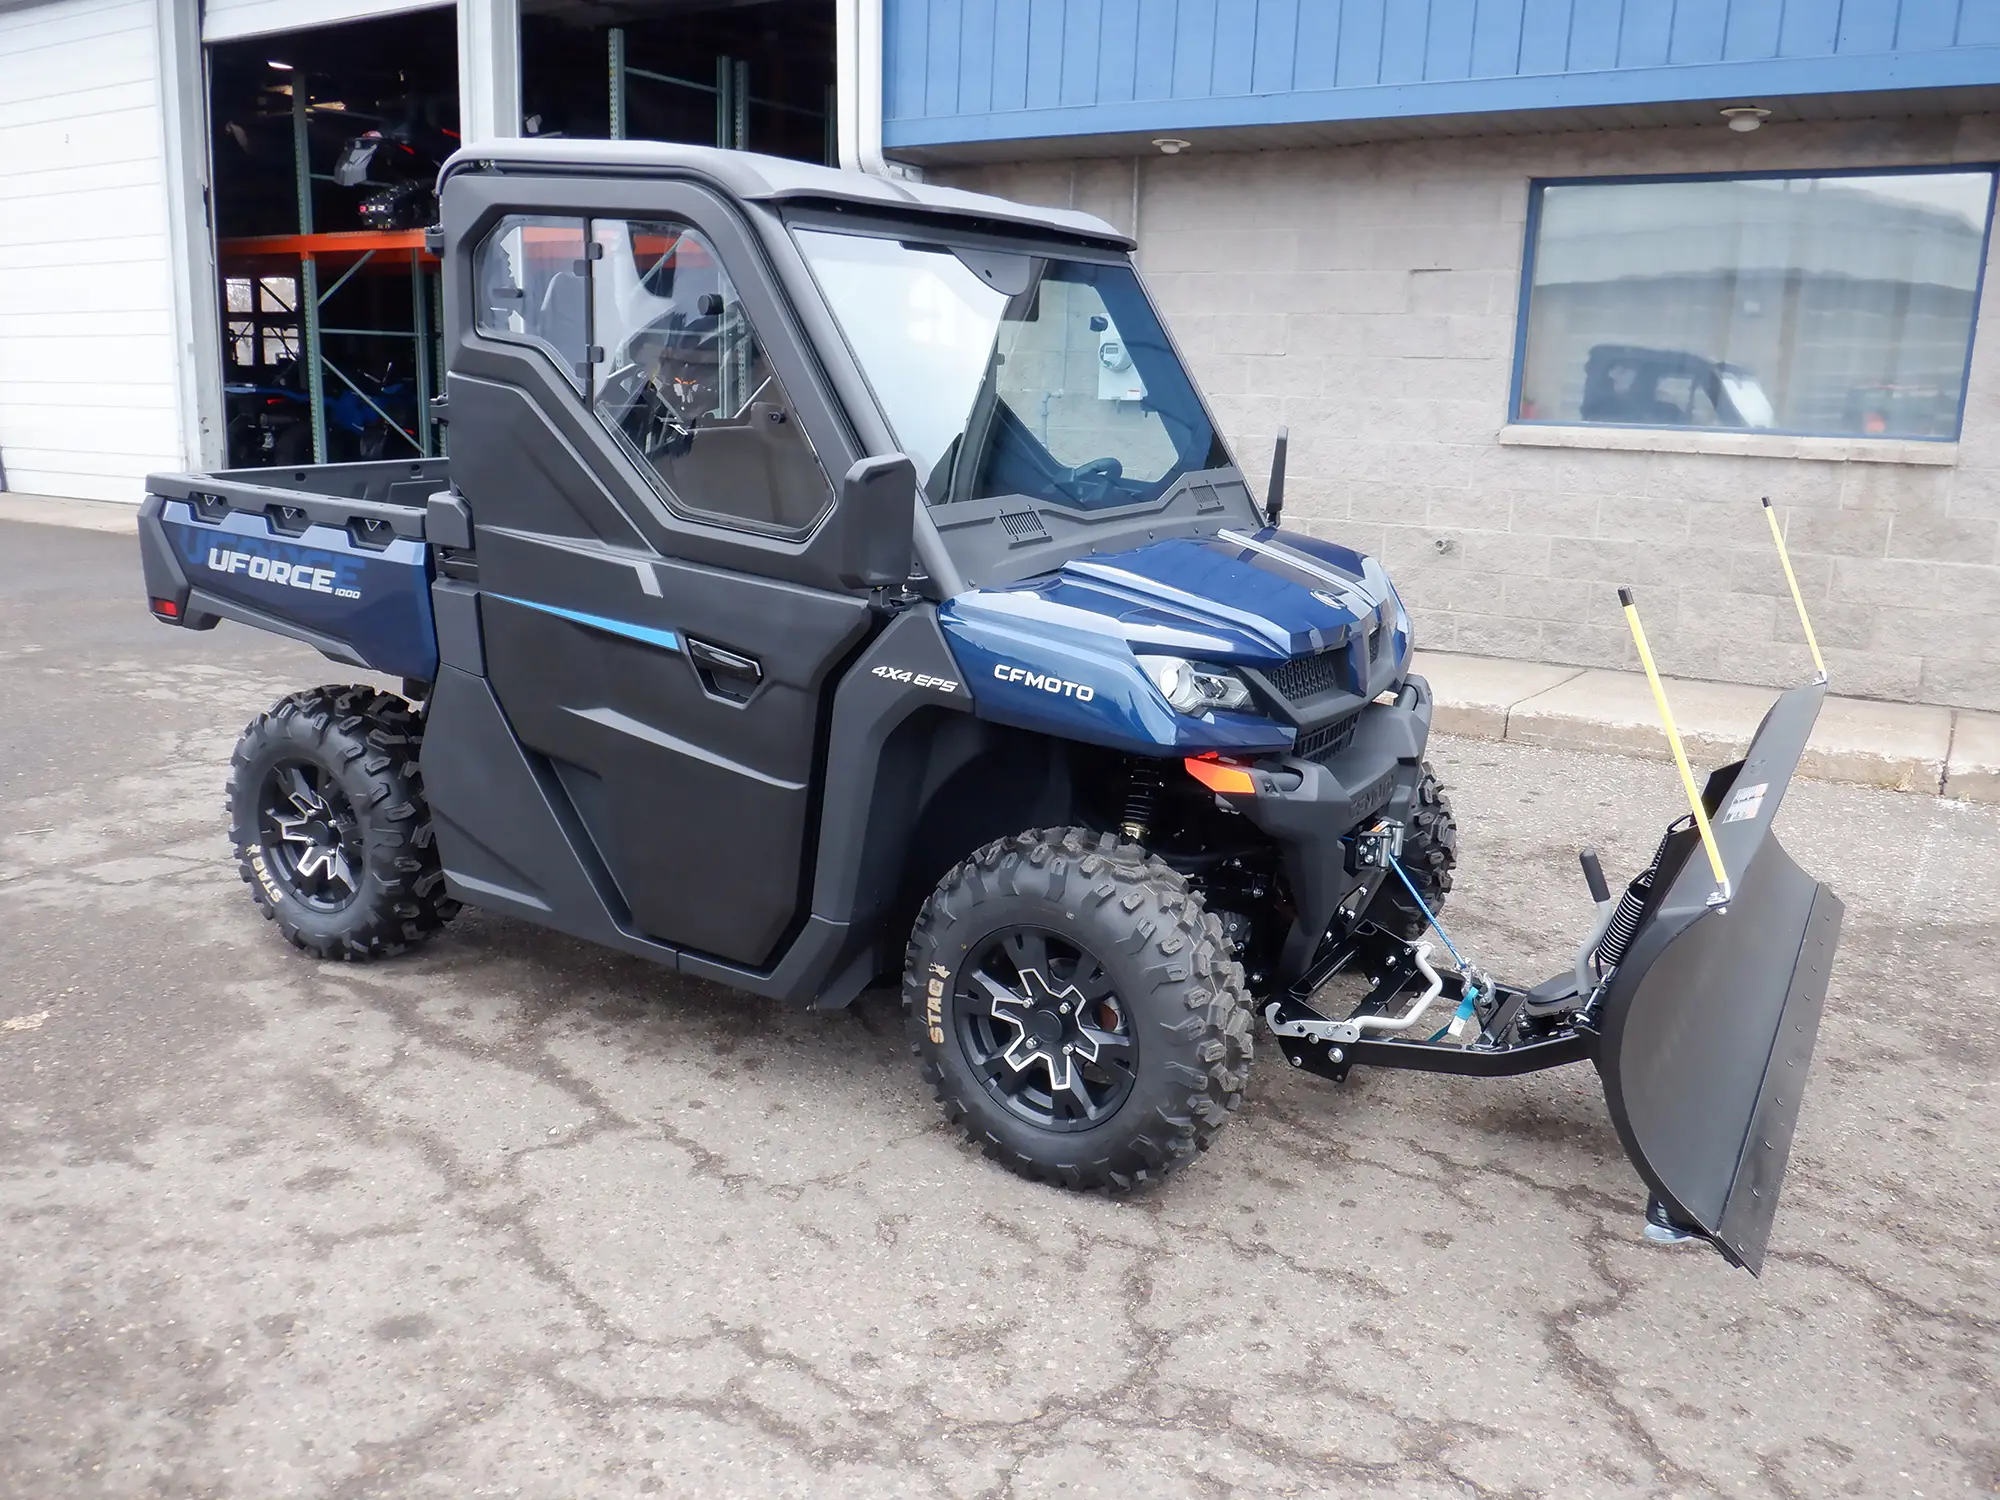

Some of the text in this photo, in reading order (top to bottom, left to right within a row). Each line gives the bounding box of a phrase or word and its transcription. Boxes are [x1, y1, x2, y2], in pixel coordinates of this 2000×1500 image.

[207, 547, 361, 600] UFORCE 1000
[871, 665, 959, 693] 4X4 EPS
[993, 663, 1095, 702] CFMOTO
